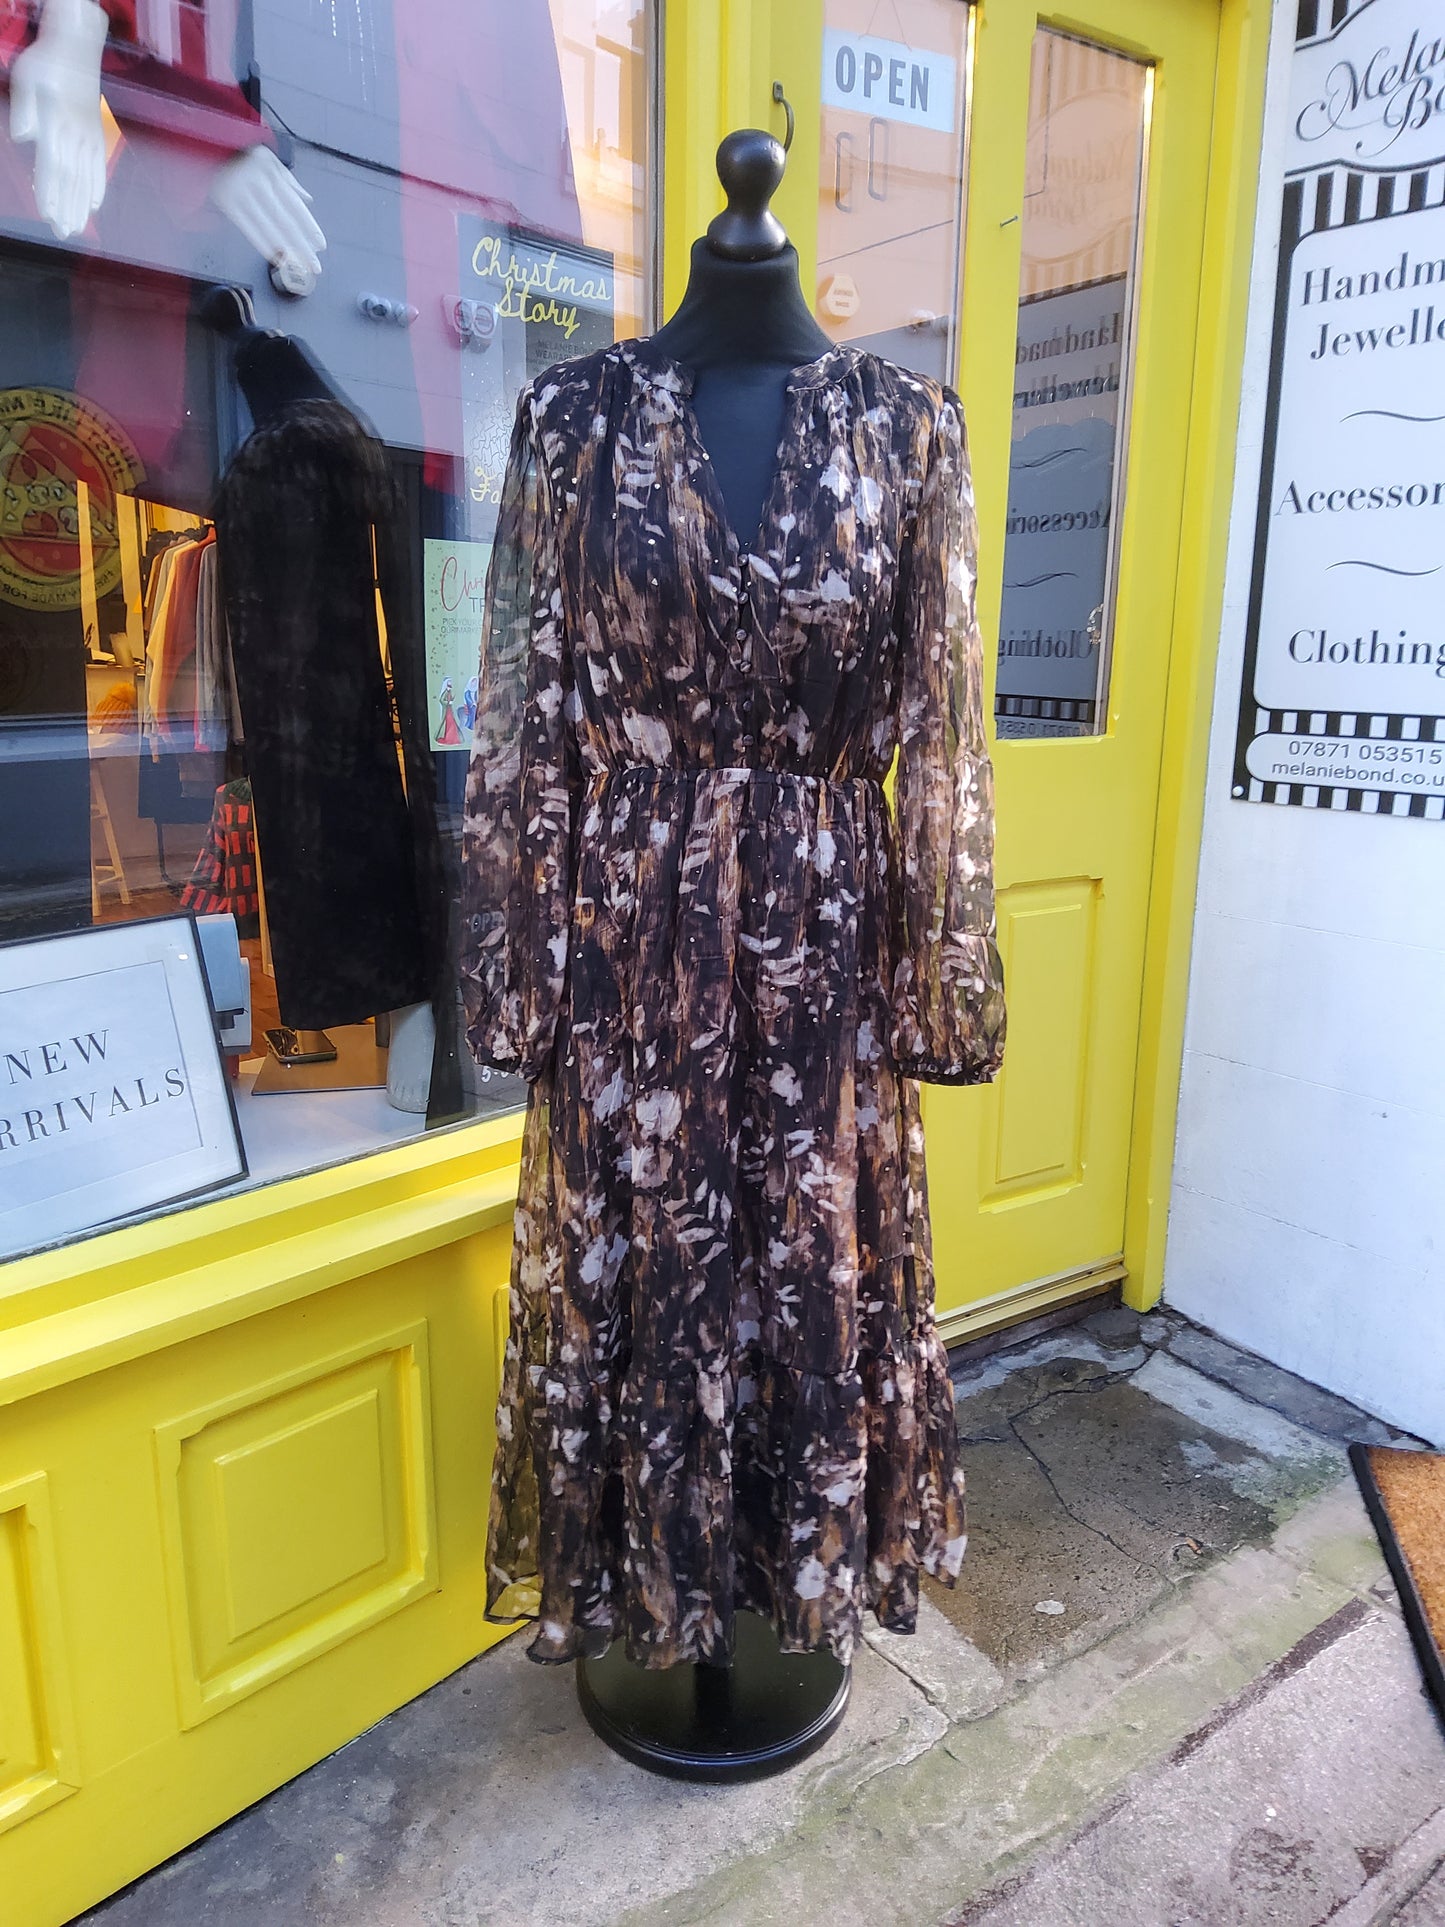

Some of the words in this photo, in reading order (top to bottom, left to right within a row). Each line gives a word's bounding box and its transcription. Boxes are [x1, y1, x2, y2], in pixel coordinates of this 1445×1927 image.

[836, 45, 930, 112] OPEN
[1296, 28, 1445, 141] Mela
[472, 236, 611, 301] Christmas
[1300, 251, 1445, 307] Handm
[498, 277, 581, 340] Story
[1288, 740, 1350, 759] 07871
[1358, 744, 1443, 765] 053515
[3, 1028, 109, 1085] NEW
